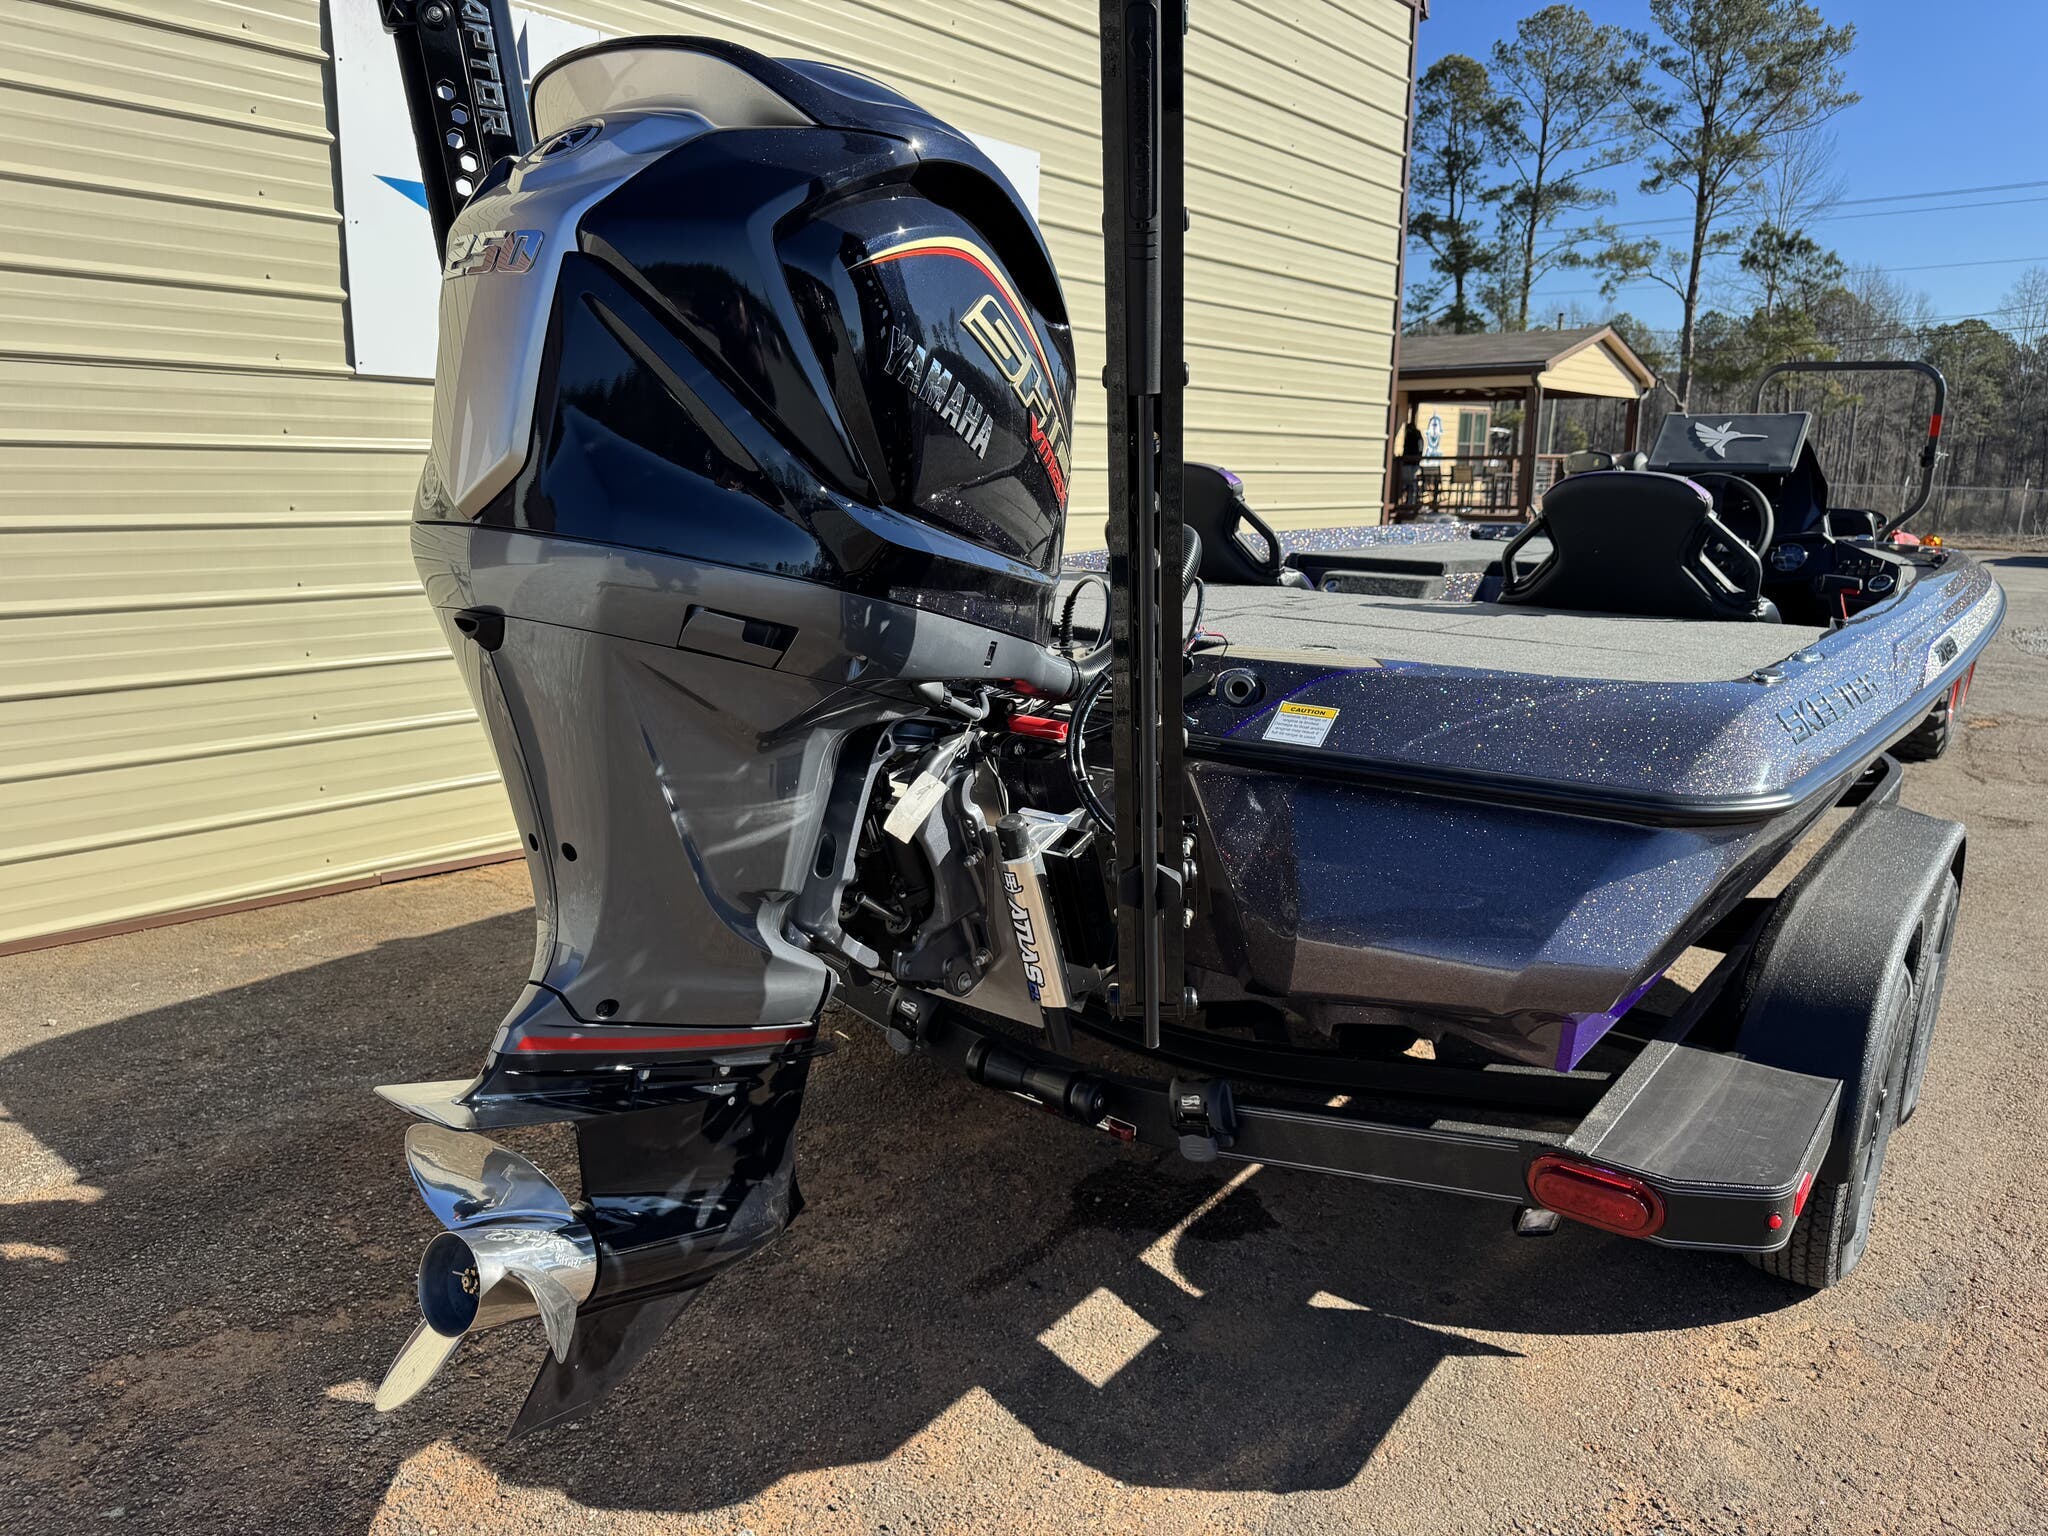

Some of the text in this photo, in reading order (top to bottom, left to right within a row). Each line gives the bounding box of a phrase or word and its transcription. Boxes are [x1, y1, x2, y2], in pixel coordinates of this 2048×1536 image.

[444, 229, 545, 280] 250
[884, 324, 994, 460] YAMAHA
[1290, 706, 1326, 715] CAUTION
[1775, 671, 1880, 746] SKEETER
[1006, 896, 1046, 988] ATLAS
